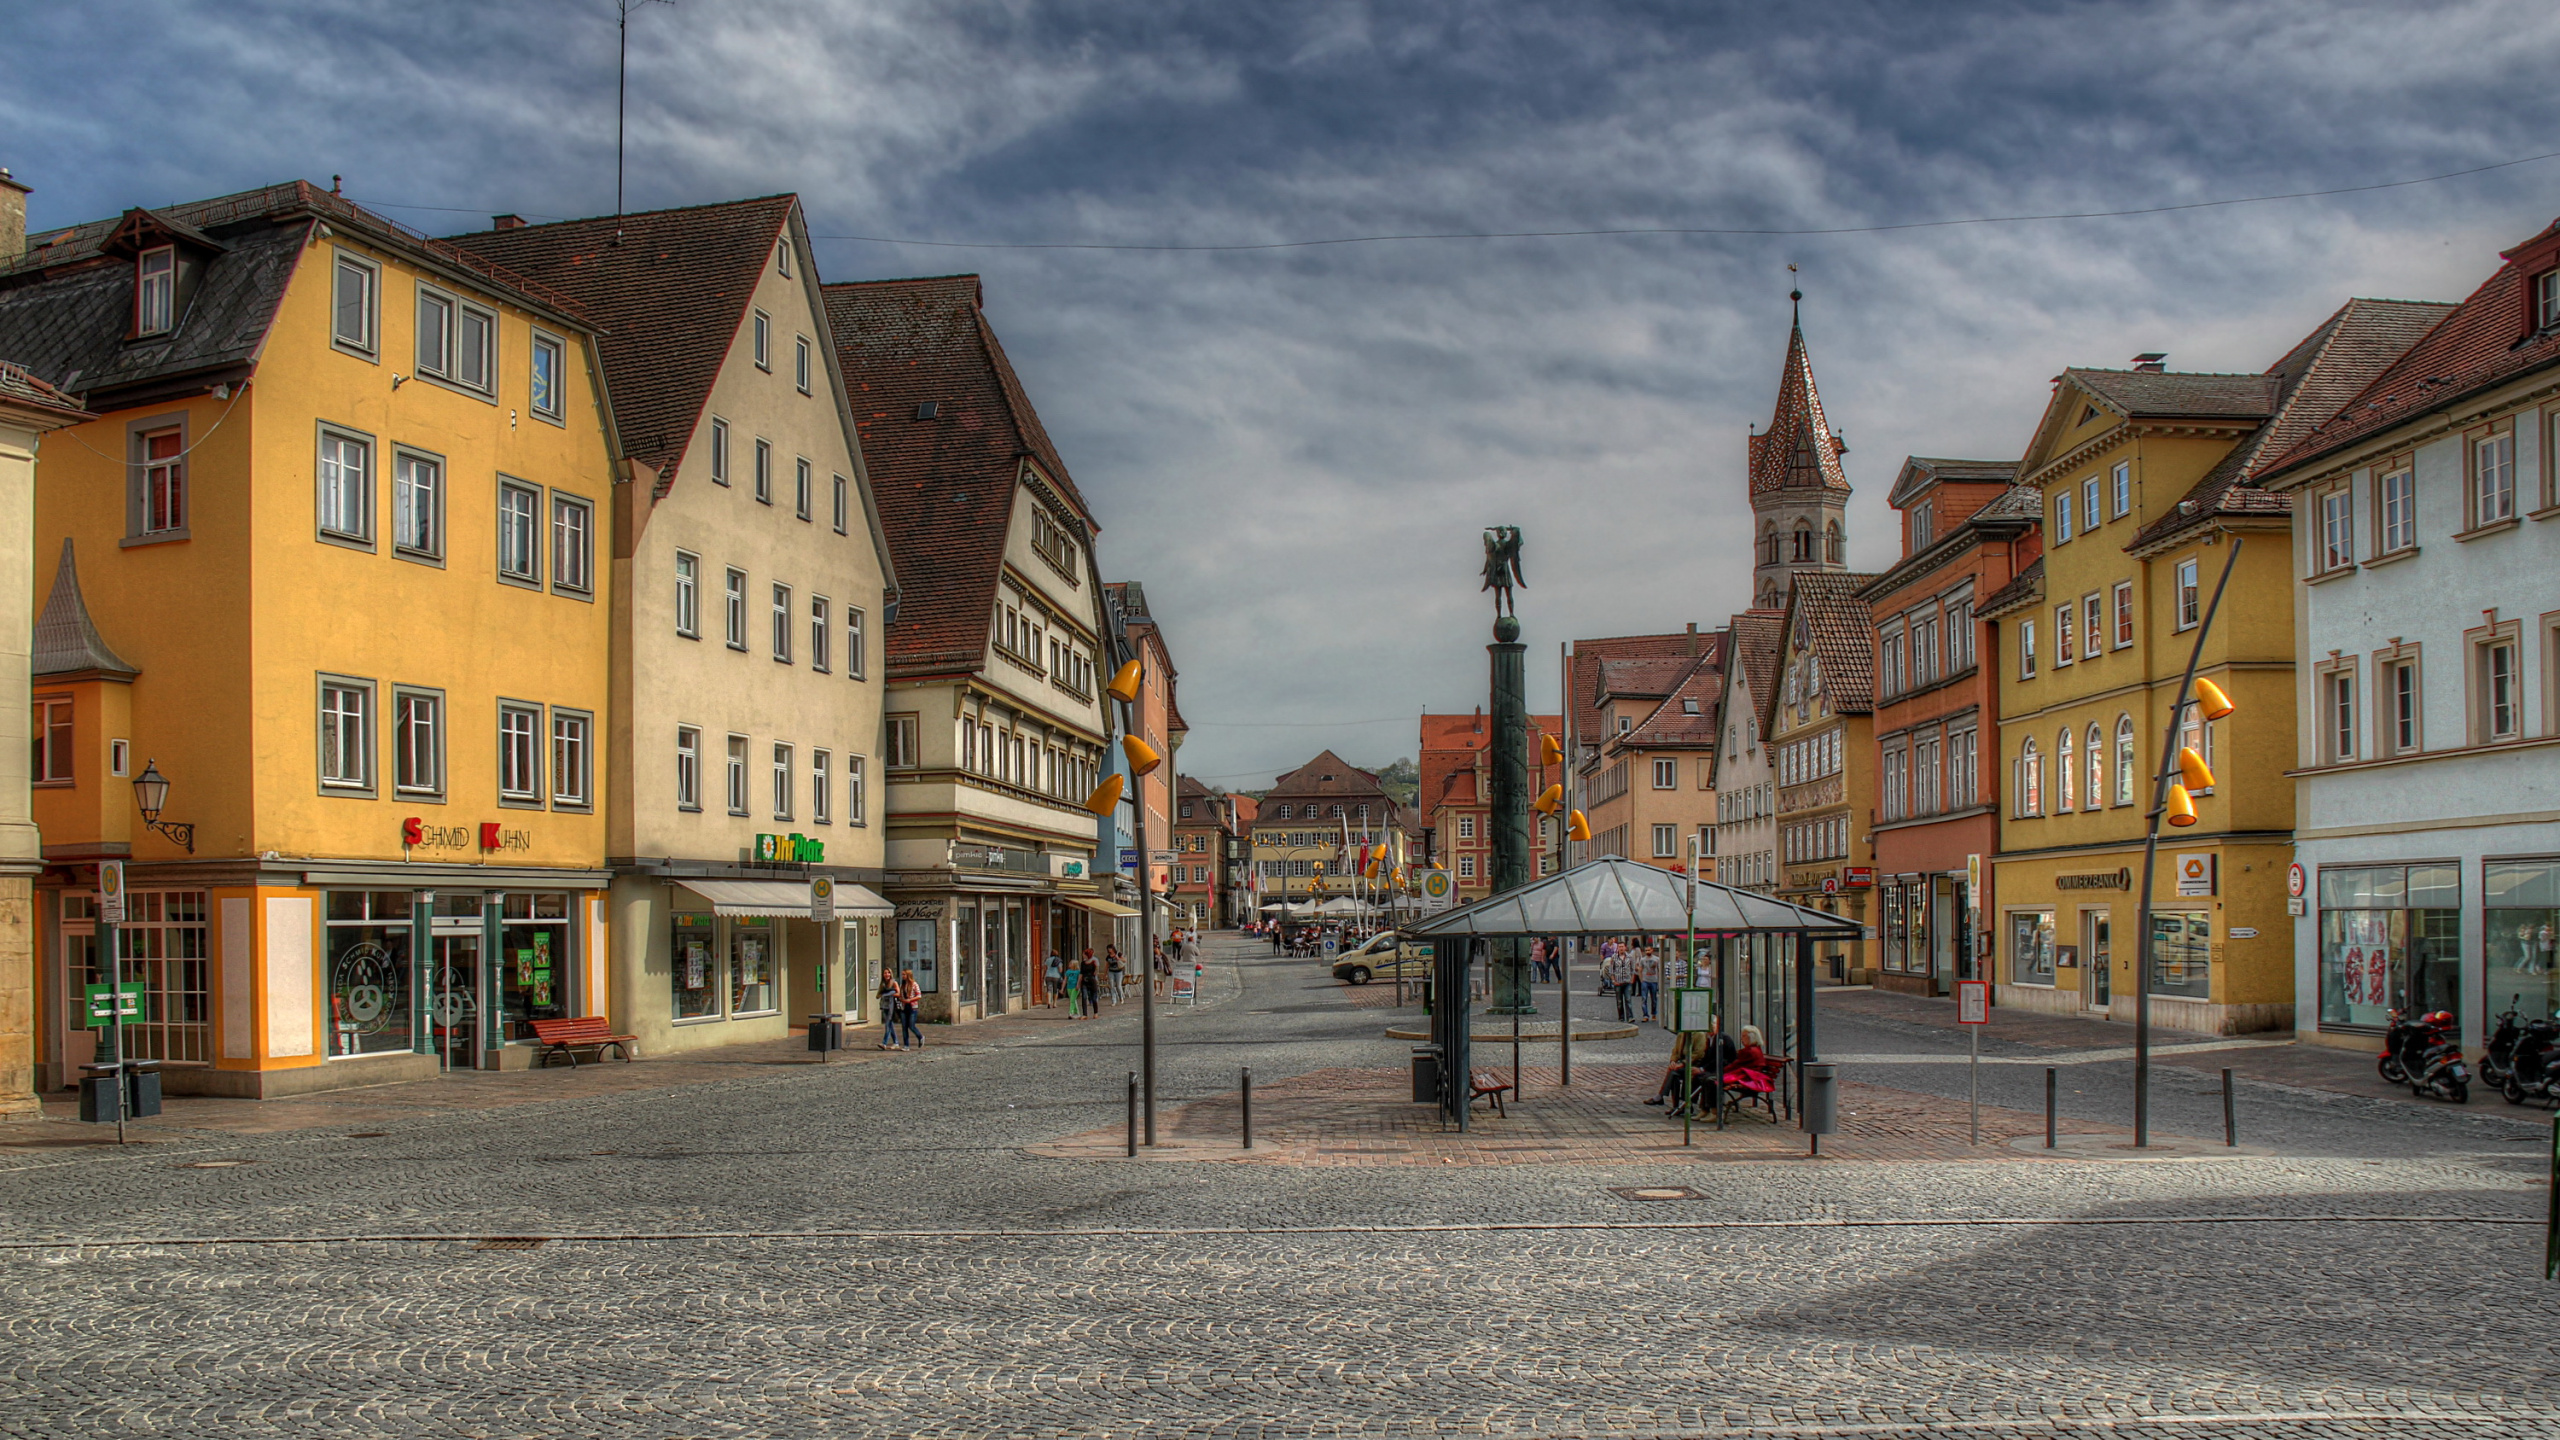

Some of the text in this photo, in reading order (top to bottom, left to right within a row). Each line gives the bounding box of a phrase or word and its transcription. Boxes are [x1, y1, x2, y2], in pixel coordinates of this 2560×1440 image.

[402, 817, 530, 849] SCHMID KUHN
[955, 850, 983, 859] pimkie
[869, 924, 879, 937] 32
